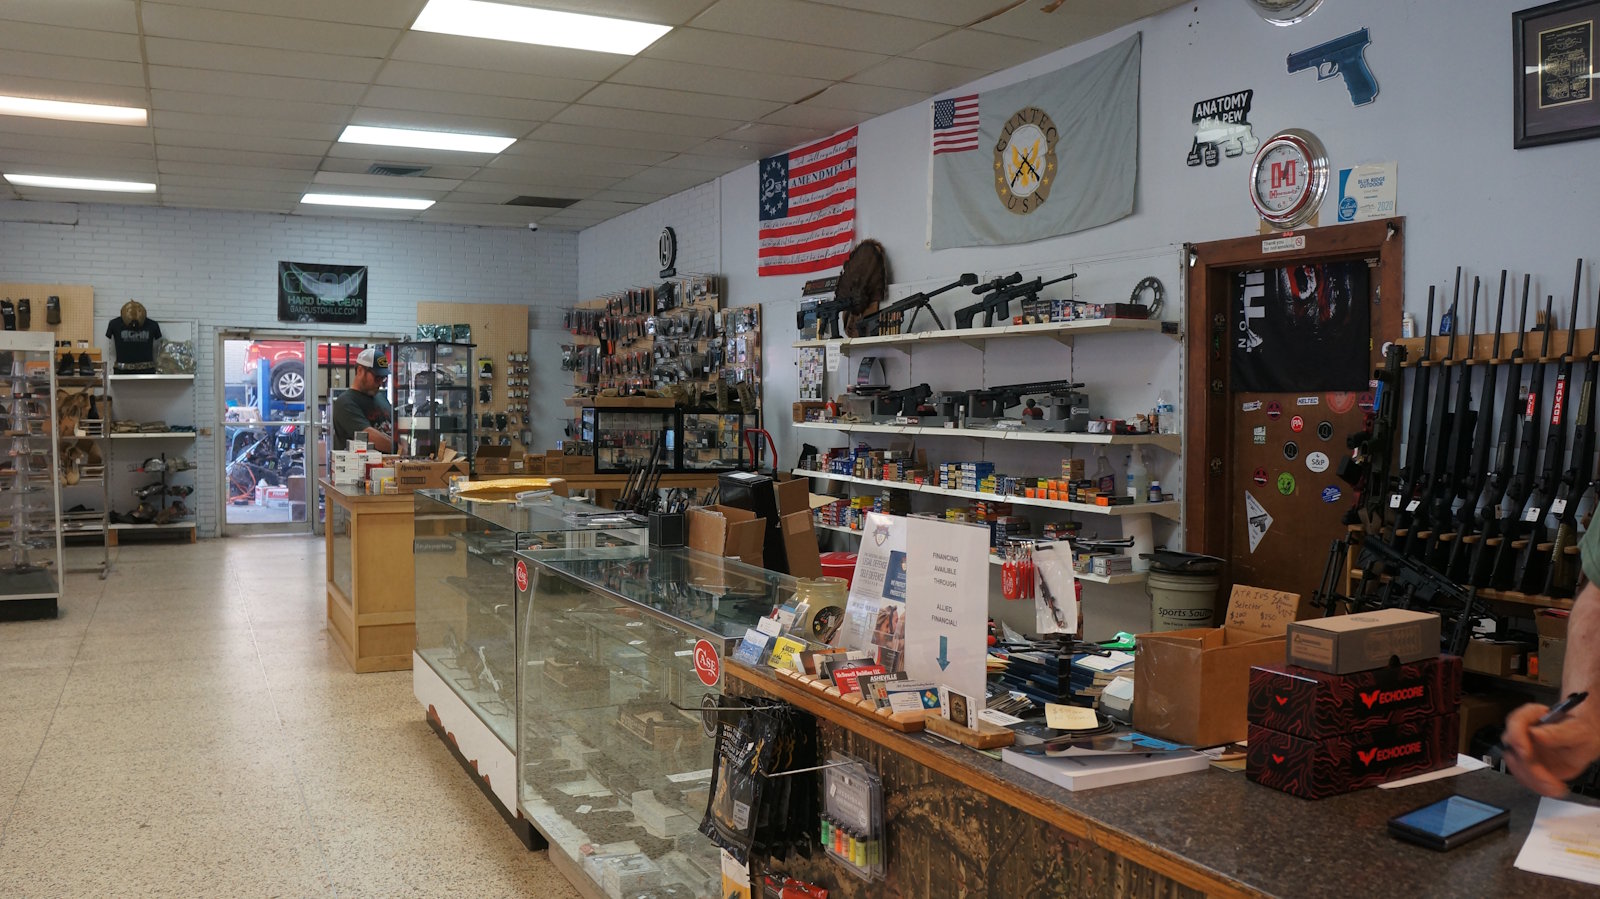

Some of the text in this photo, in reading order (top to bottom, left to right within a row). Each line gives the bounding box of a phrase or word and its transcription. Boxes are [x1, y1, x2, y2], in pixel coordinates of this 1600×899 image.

[1196, 92, 1249, 118] ANATOMY
[1200, 109, 1243, 129] OF A PEW
[997, 108, 1057, 152] GUNTEC
[1008, 192, 1045, 213] USA
[1377, 201, 1393, 211] 2020
[287, 295, 363, 308] HARD USE GEAR
[1552, 382, 1564, 422] SAVAGE
[932, 552, 959, 563] FINANCING
[933, 577, 957, 588] THROUGH
[936, 603, 953, 613] ALLIED
[1158, 607, 1186, 618] Sports
[931, 614, 958, 627] FINANCIAL!
[695, 647, 717, 677] CASE
[870, 673, 897, 682] ASHEVILLE
[1379, 685, 1424, 705] ECHOCORE
[1376, 741, 1422, 762] ECHOCORE
